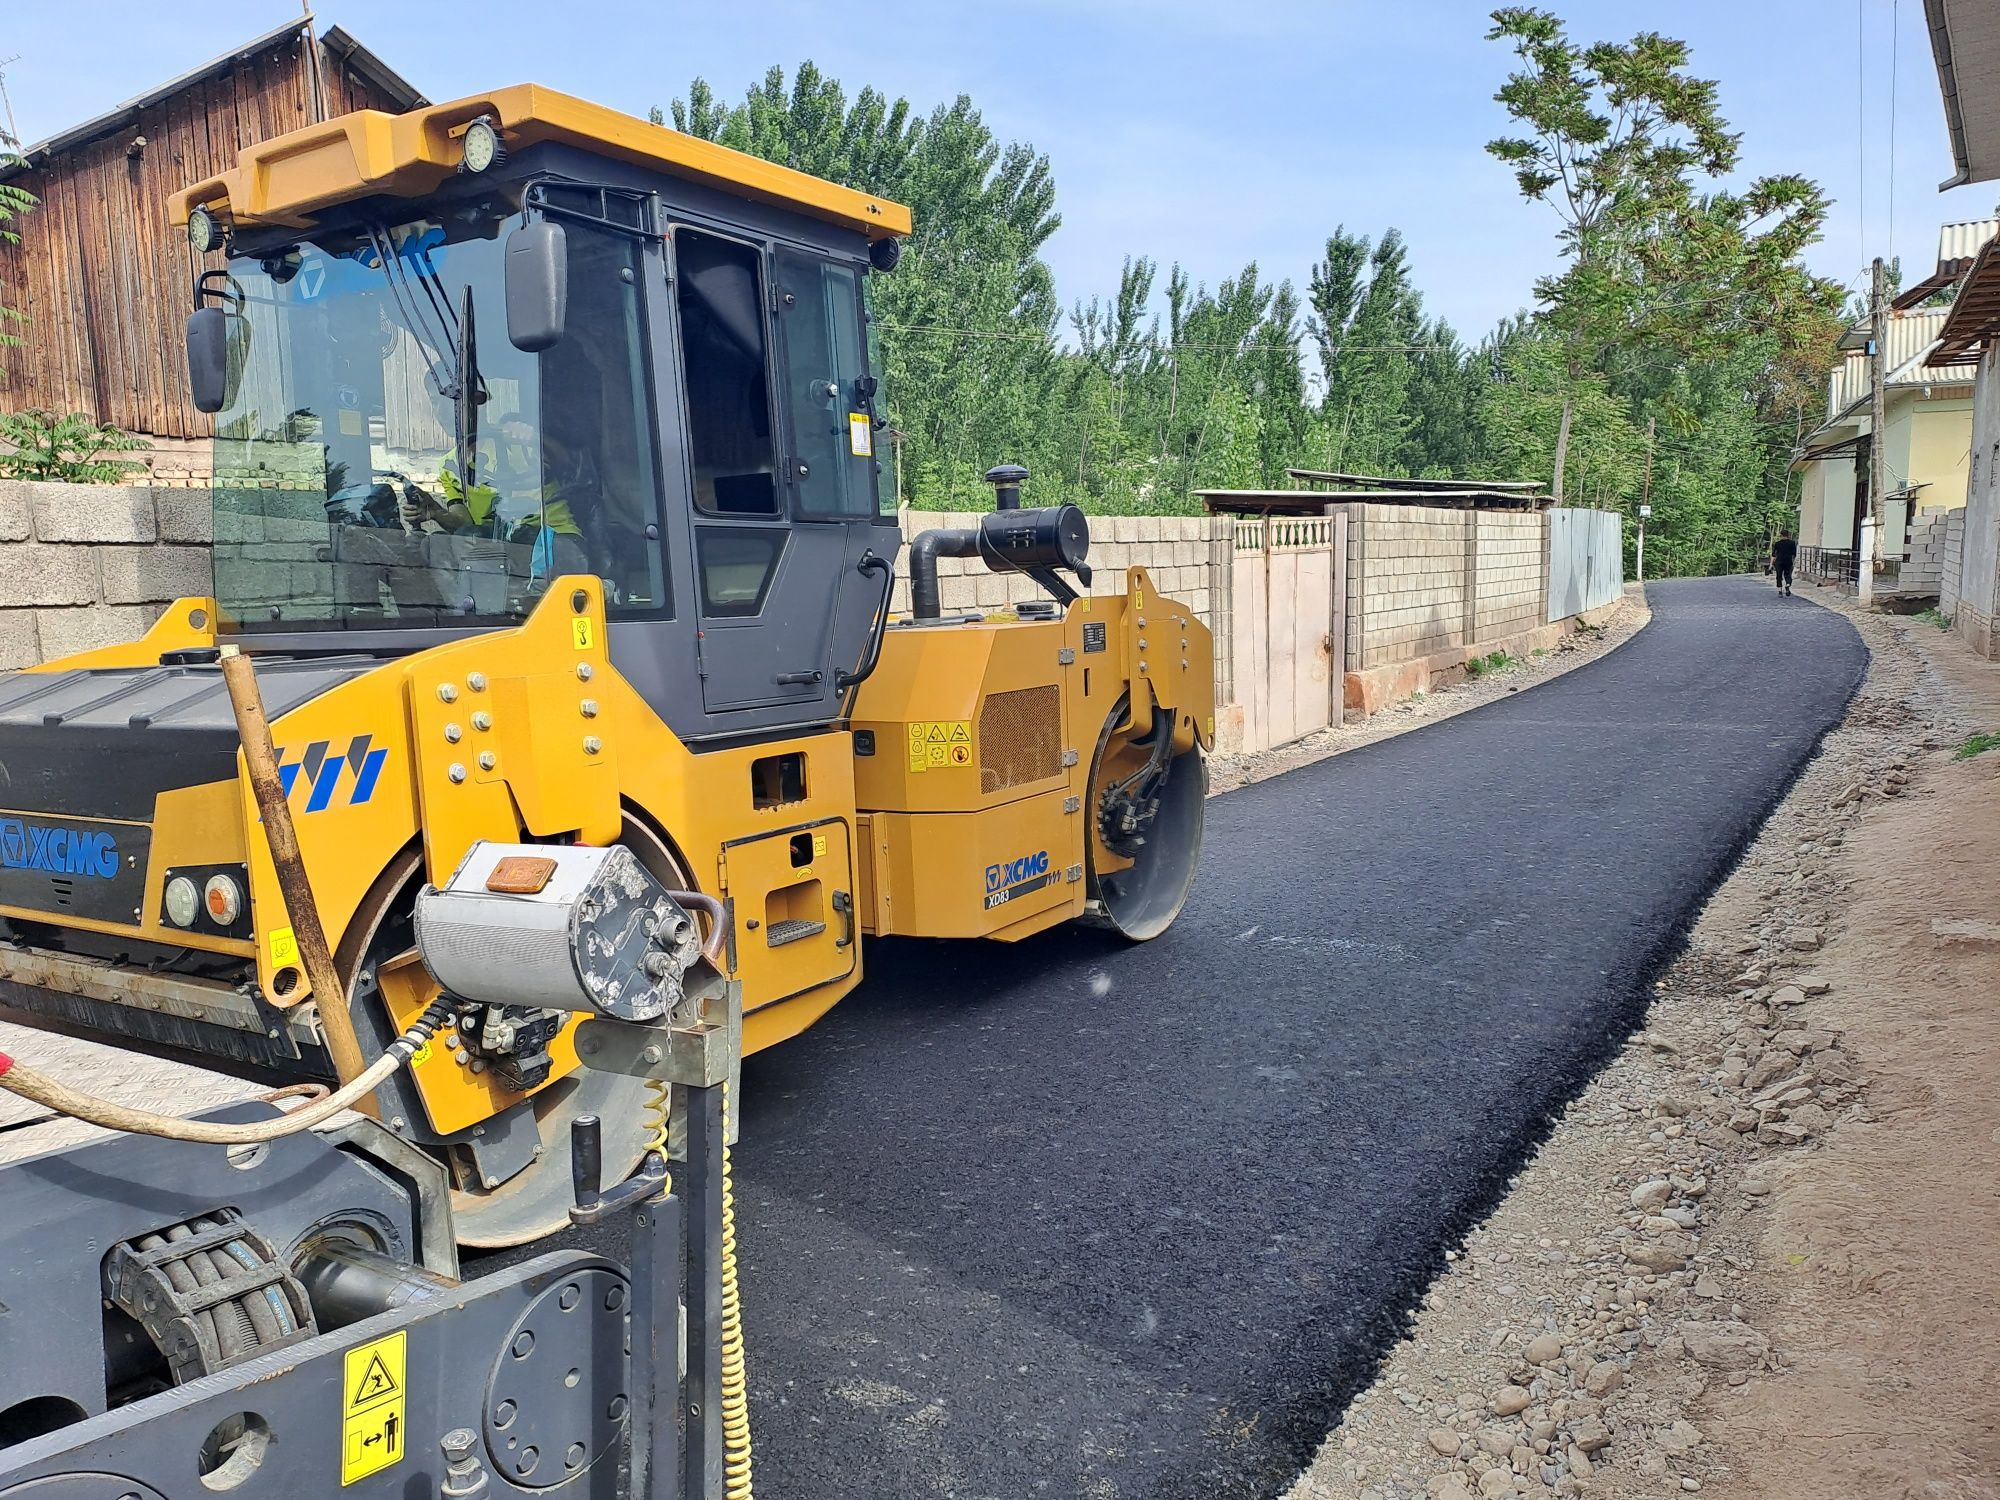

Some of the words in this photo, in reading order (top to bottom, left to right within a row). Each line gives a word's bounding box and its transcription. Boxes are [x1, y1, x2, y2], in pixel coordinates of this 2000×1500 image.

[28, 826, 119, 879] XCMG
[1001, 851, 1048, 888] XCMG
[988, 889, 1009, 908] XD83
